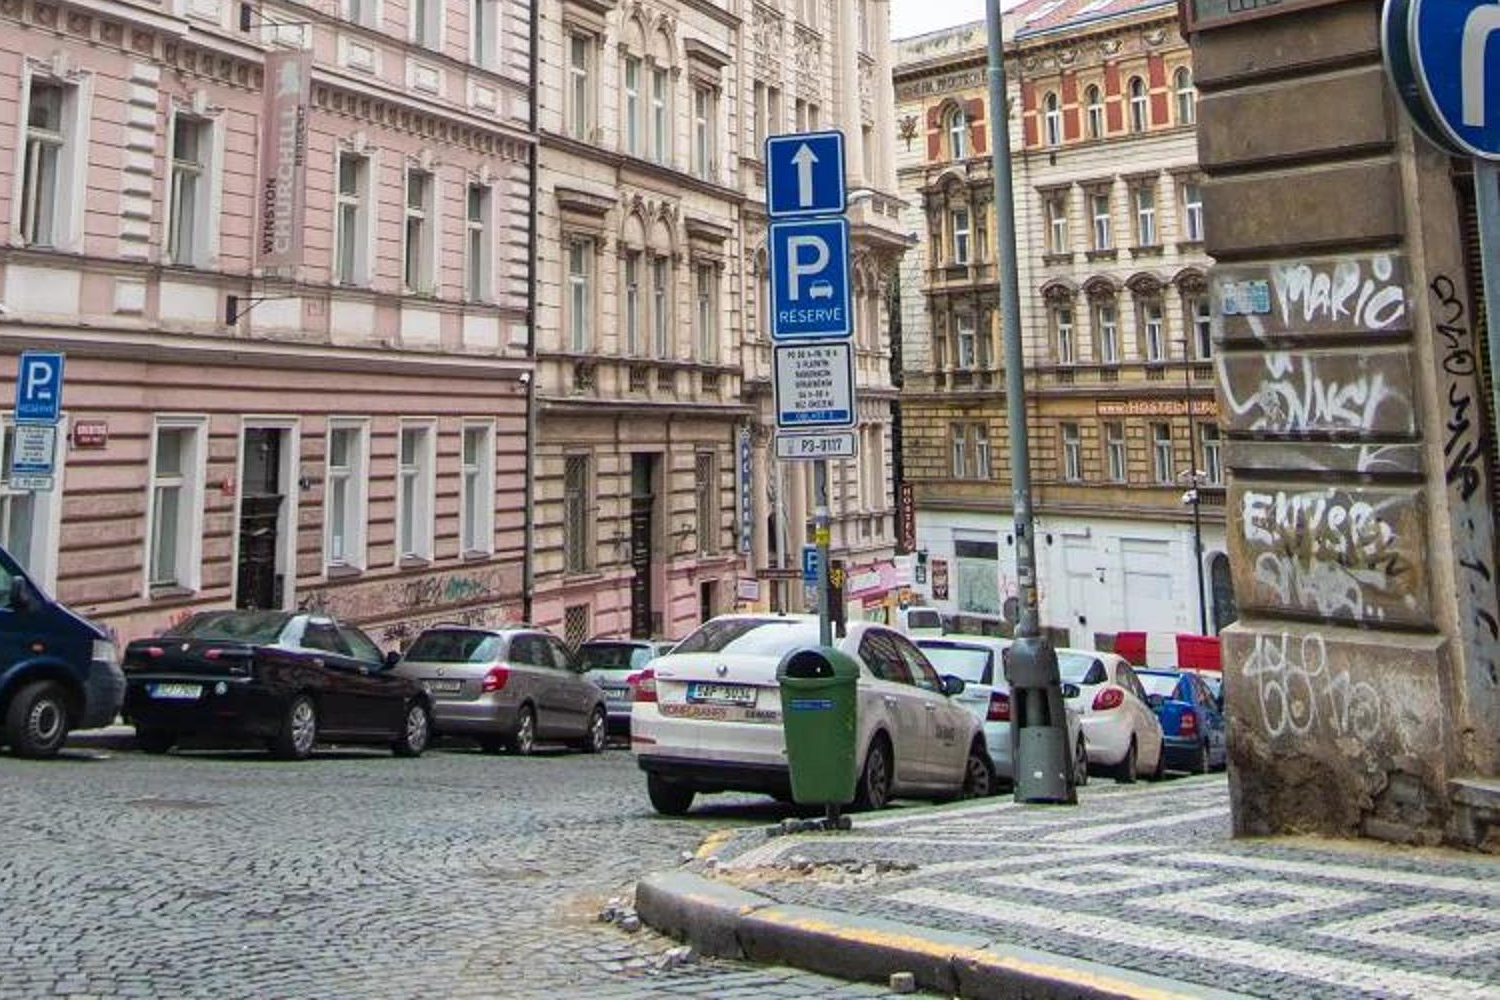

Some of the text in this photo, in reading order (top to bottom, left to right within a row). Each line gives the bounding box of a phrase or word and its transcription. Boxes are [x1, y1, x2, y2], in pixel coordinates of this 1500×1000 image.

[275, 102, 296, 255] CHURCHILL
[263, 177, 276, 255] WINSTON
[788, 235, 830, 301] P
[27, 362, 53, 399] P
